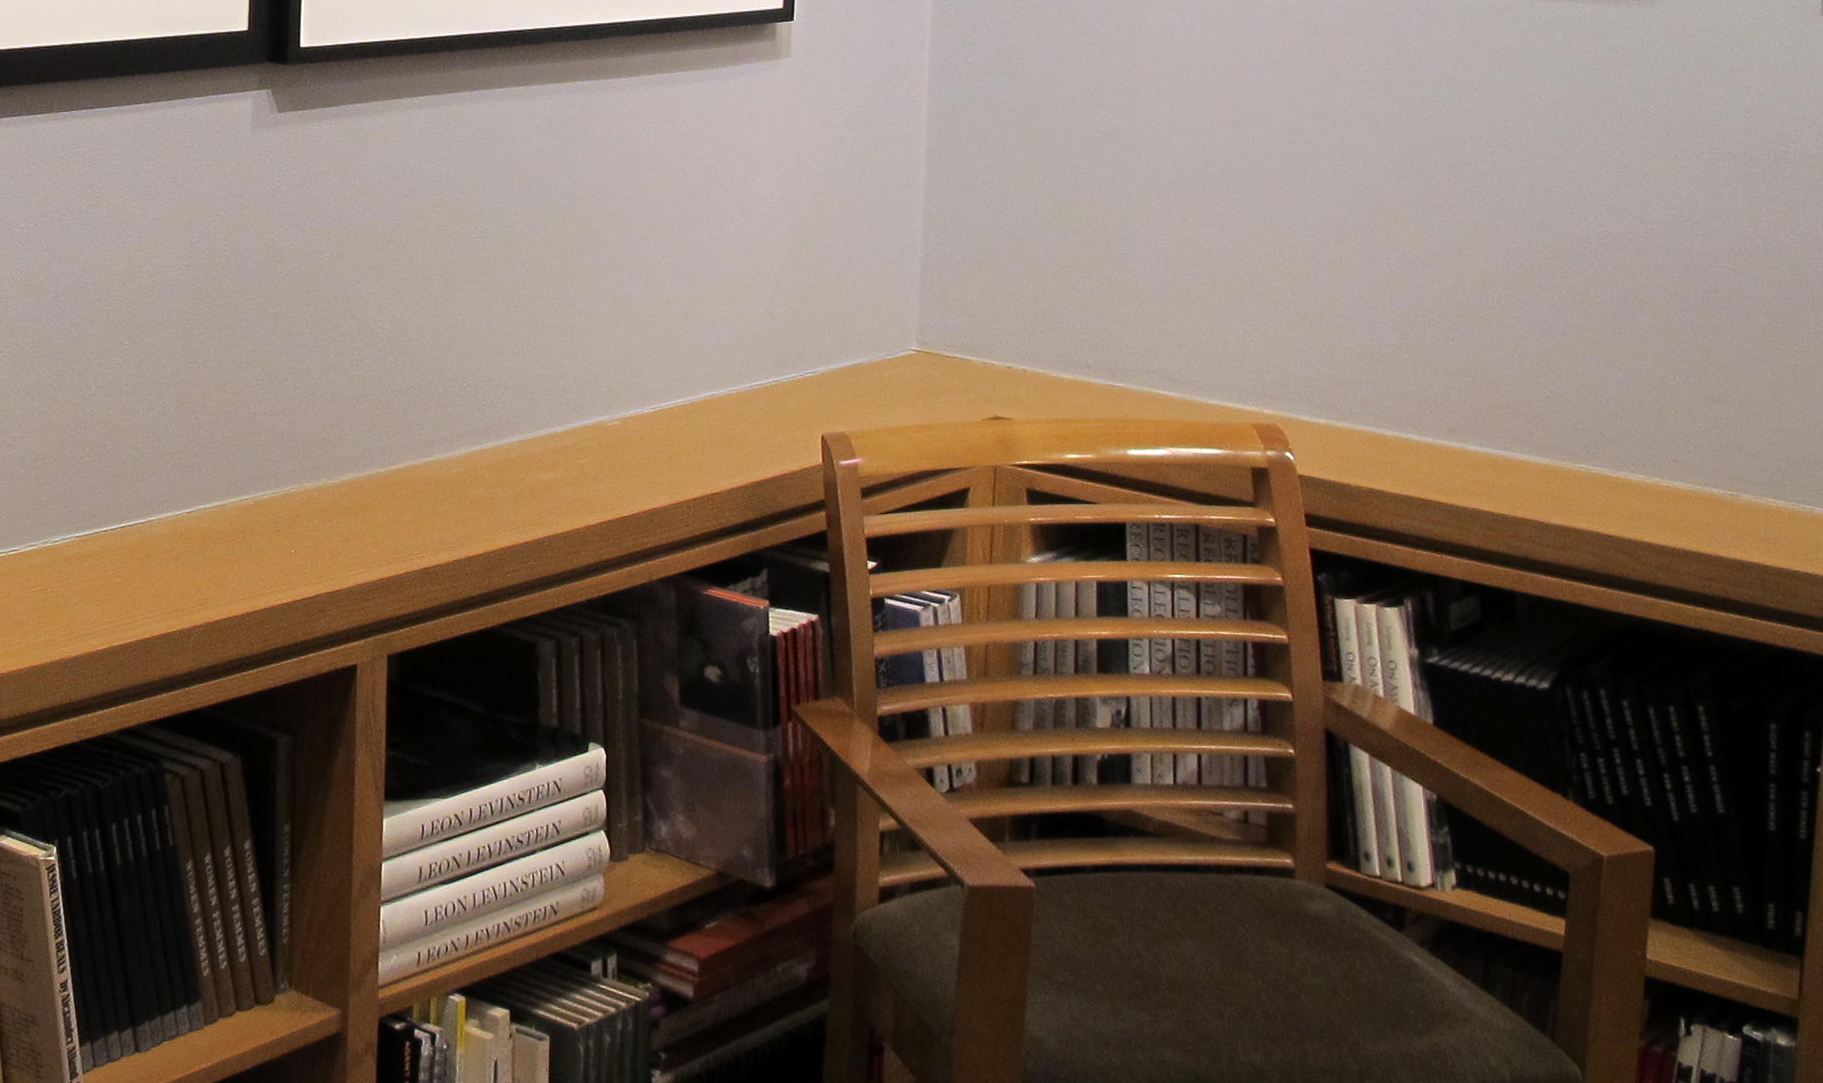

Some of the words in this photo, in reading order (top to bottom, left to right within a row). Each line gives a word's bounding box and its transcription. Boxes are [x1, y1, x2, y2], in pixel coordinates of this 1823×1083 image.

[420, 810, 465, 840] LEON
[468, 777, 563, 823] LEVINSTEIN
[417, 852, 463, 883] LEON
[466, 820, 562, 865] LEVINSTEIN
[423, 896, 468, 926] LEON
[472, 861, 566, 902] LEVINSTEIN
[415, 937, 461, 967] LEON
[464, 901, 559, 950] LEVINSTEIN
